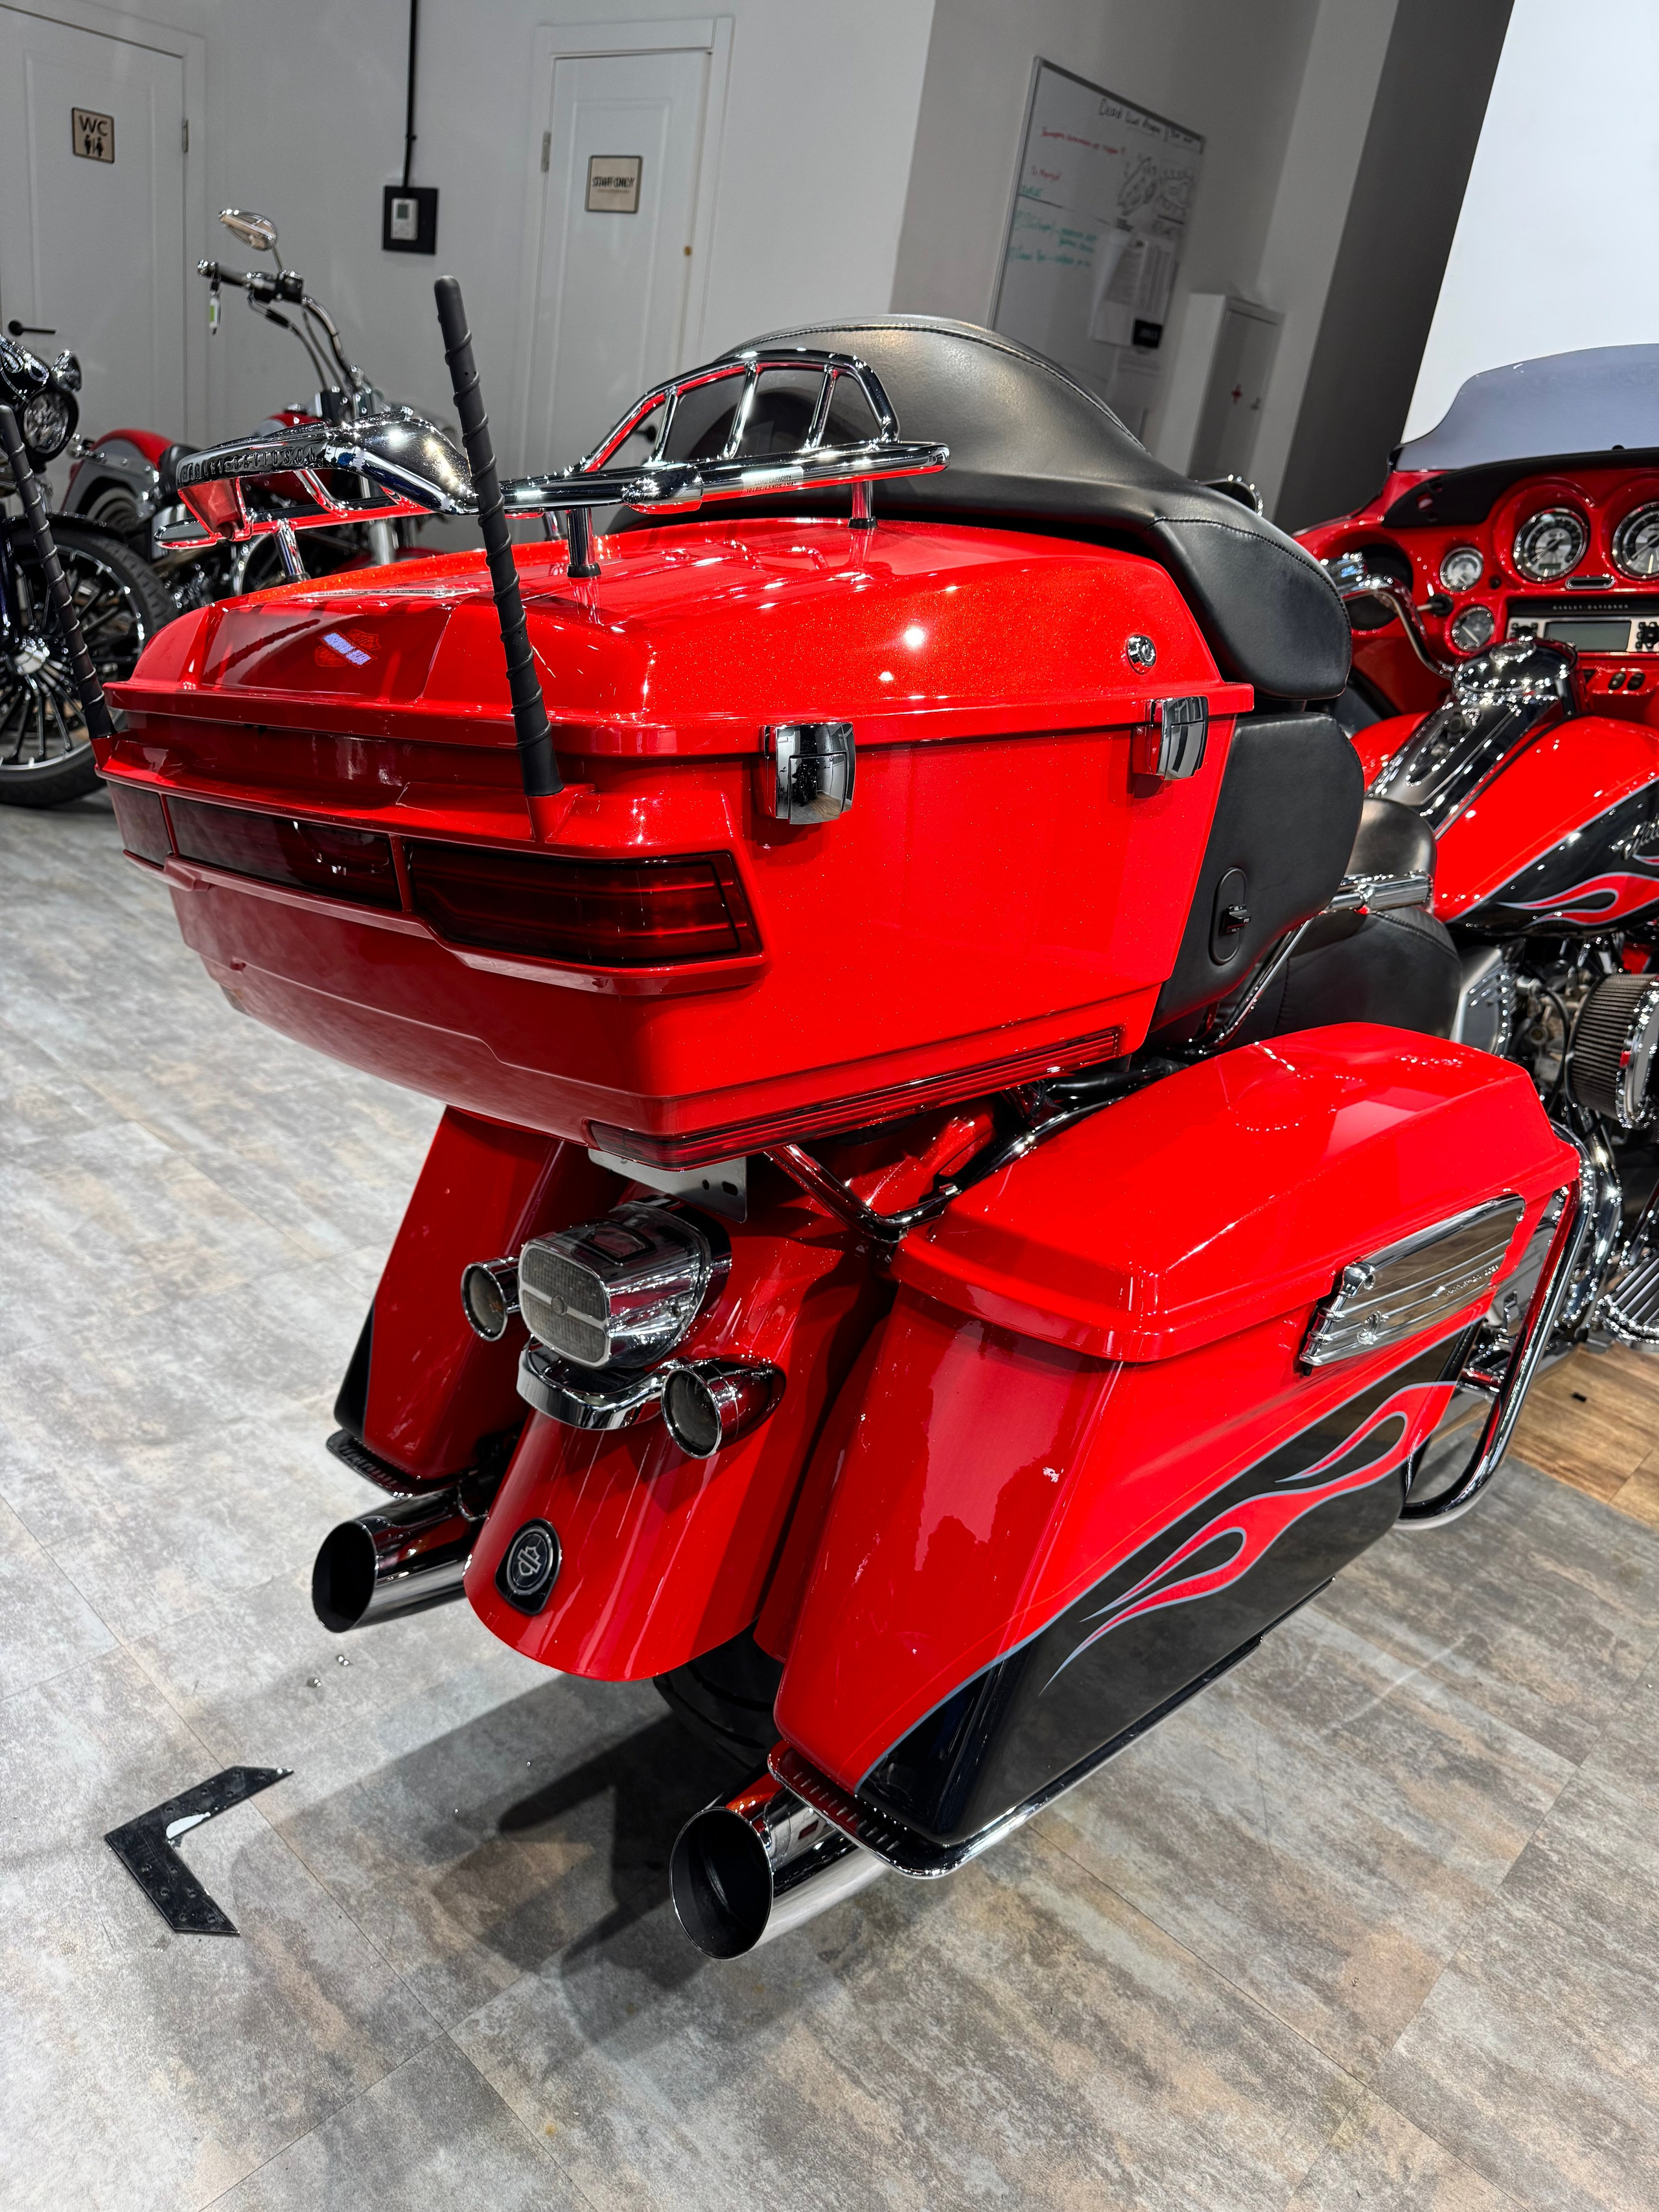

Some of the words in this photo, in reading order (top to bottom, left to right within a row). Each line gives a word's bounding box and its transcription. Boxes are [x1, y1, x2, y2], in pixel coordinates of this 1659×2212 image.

[78, 115, 108, 137] WC
[592, 176, 612, 187] STAFF
[613, 176, 635, 188] ONLY
